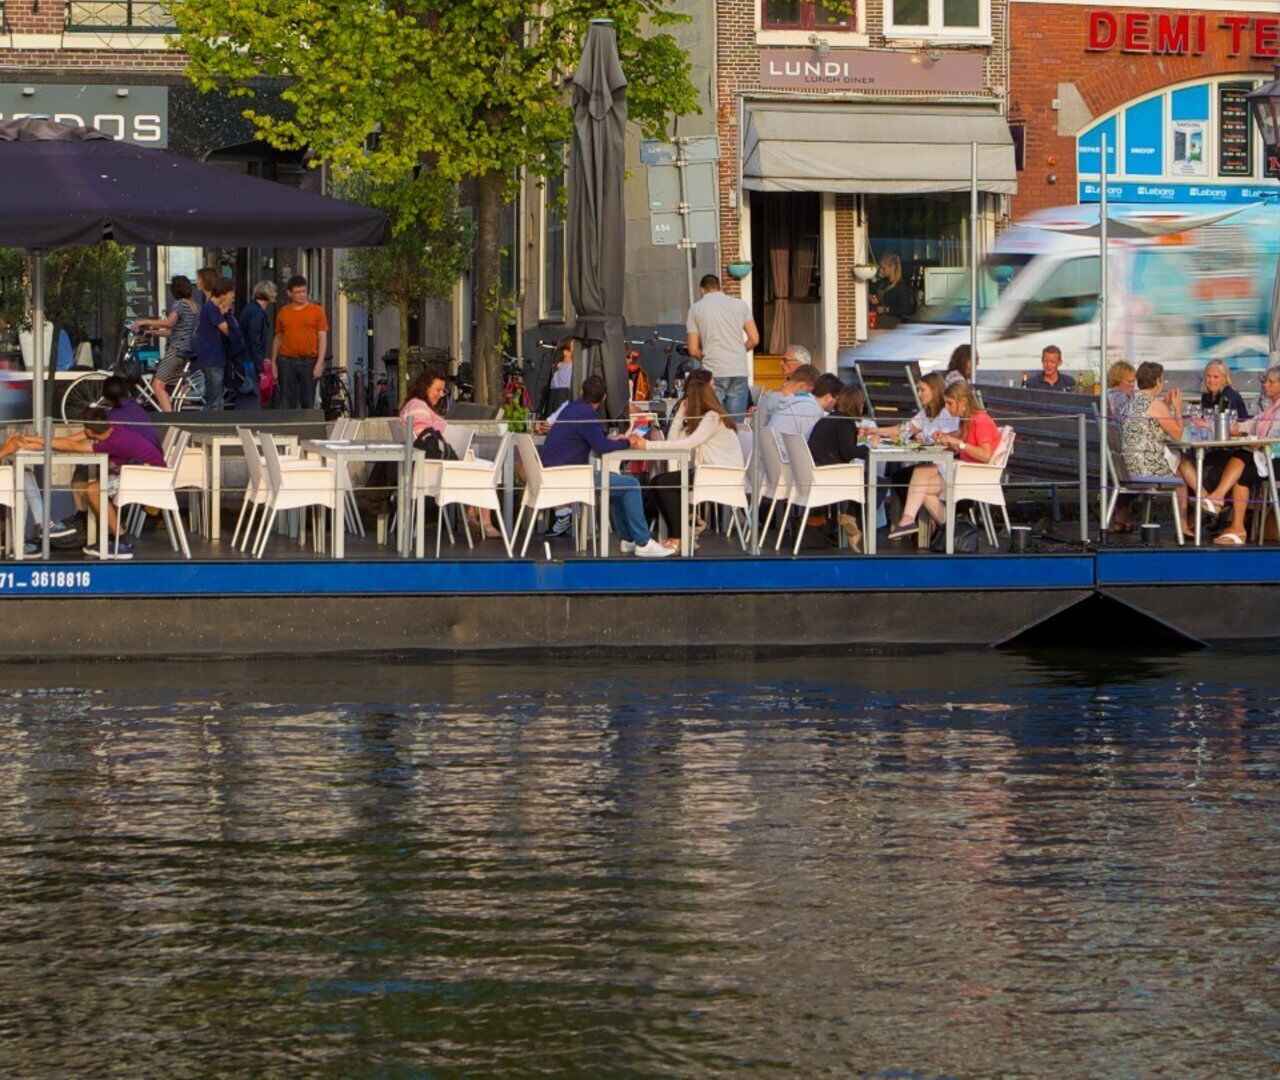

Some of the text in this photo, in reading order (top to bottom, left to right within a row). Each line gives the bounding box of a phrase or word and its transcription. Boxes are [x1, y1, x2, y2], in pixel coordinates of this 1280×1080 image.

[1088, 11, 1206, 56] DEMI
[769, 61, 849, 77] LUNDI
[1144, 187, 1175, 197] Lebara
[1197, 188, 1227, 198] Lebara
